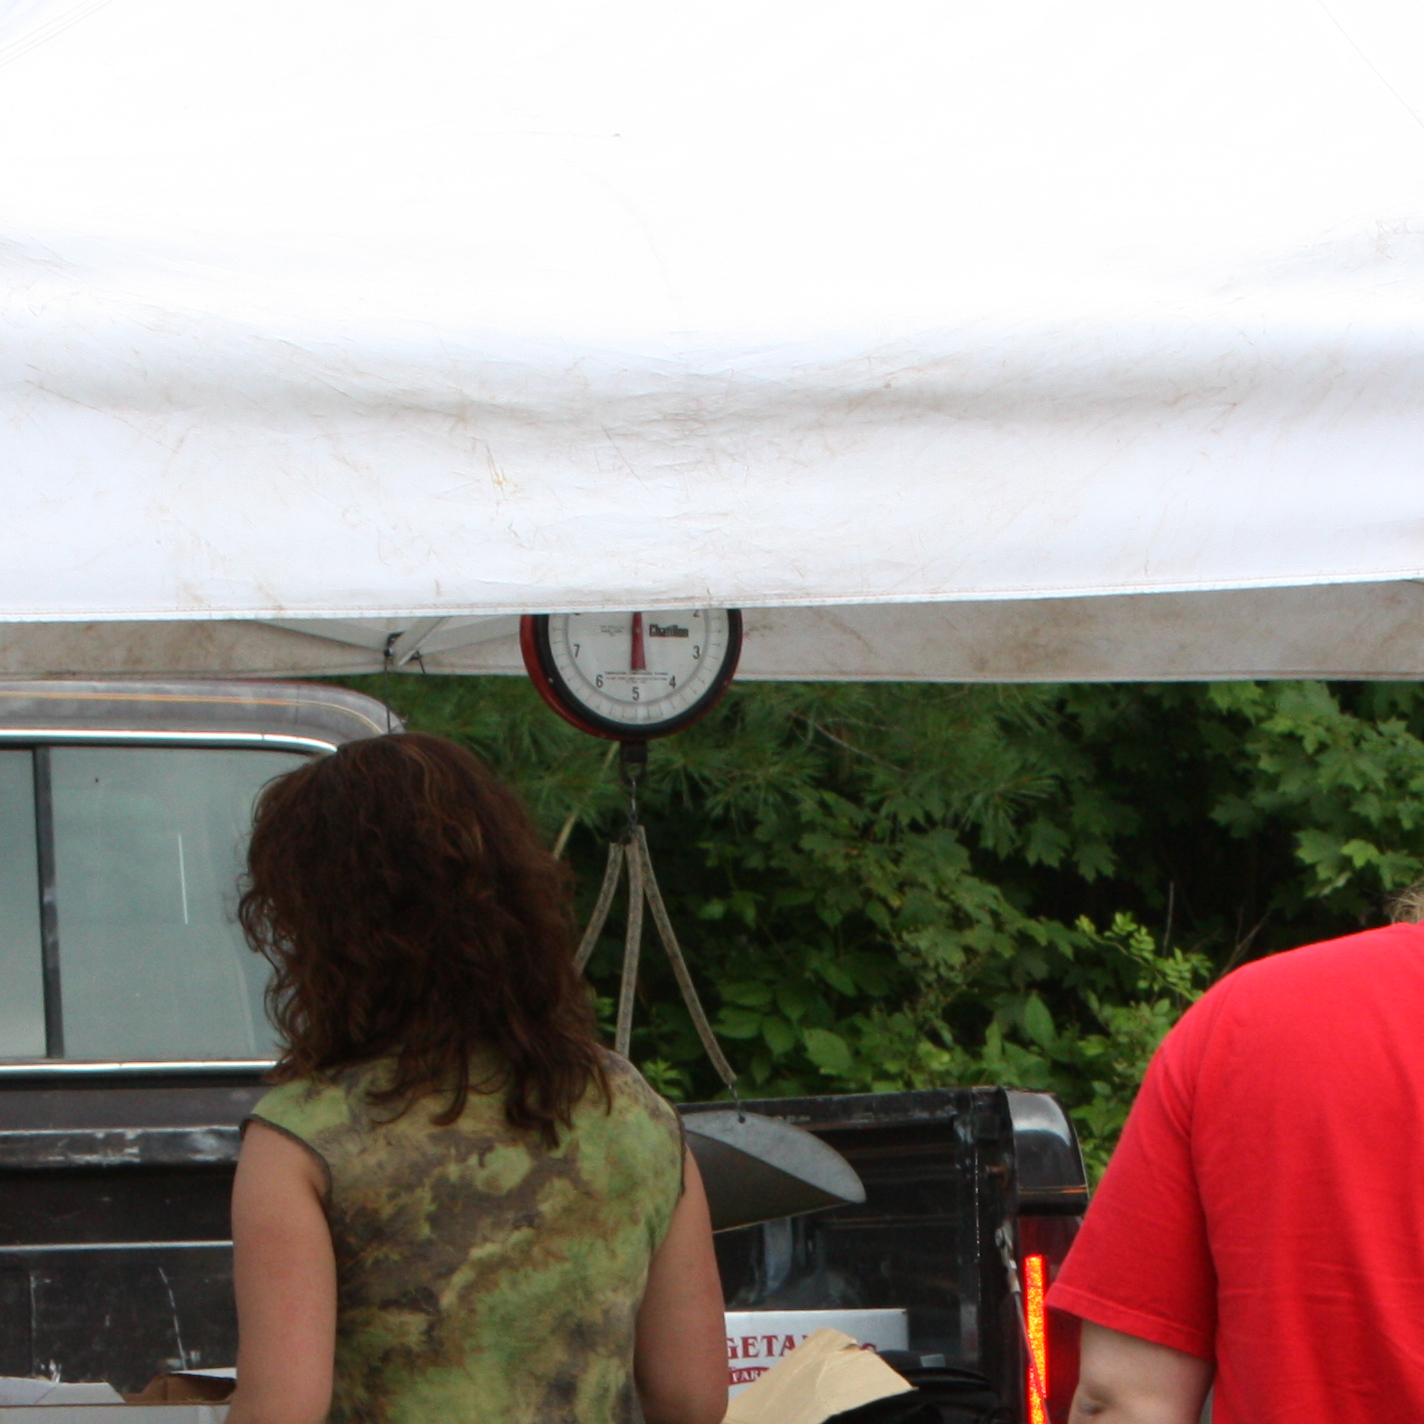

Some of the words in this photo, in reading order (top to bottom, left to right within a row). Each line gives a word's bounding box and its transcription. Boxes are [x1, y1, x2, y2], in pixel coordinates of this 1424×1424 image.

[692, 645, 701, 660] 3
[595, 674, 604, 688] 6
[668, 675, 676, 689] 4
[632, 687, 640, 702] 5
